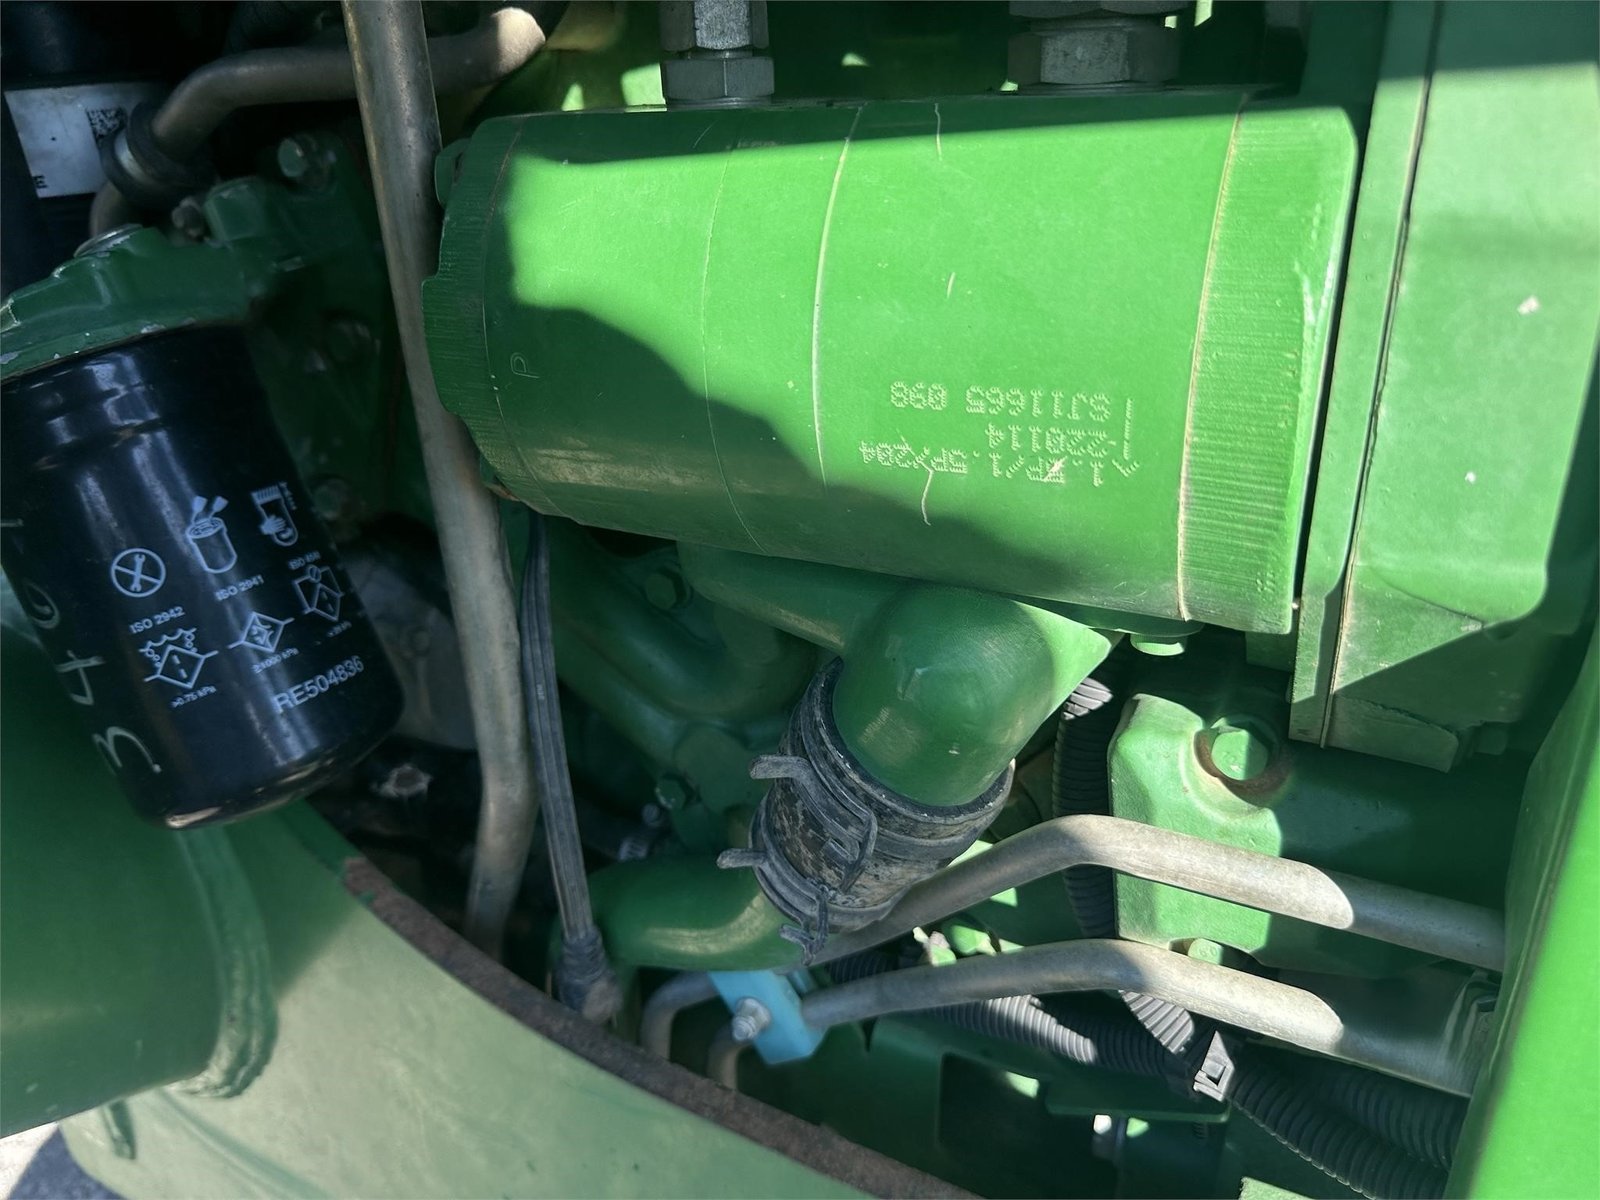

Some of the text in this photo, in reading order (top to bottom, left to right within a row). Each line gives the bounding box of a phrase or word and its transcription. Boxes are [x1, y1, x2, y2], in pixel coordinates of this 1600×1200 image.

[965, 384, 1112, 422] SJ11665
[214, 574, 265, 602] ISO 2941
[129, 606, 186, 635] ISO 2942
[271, 654, 366, 715] RE504836
